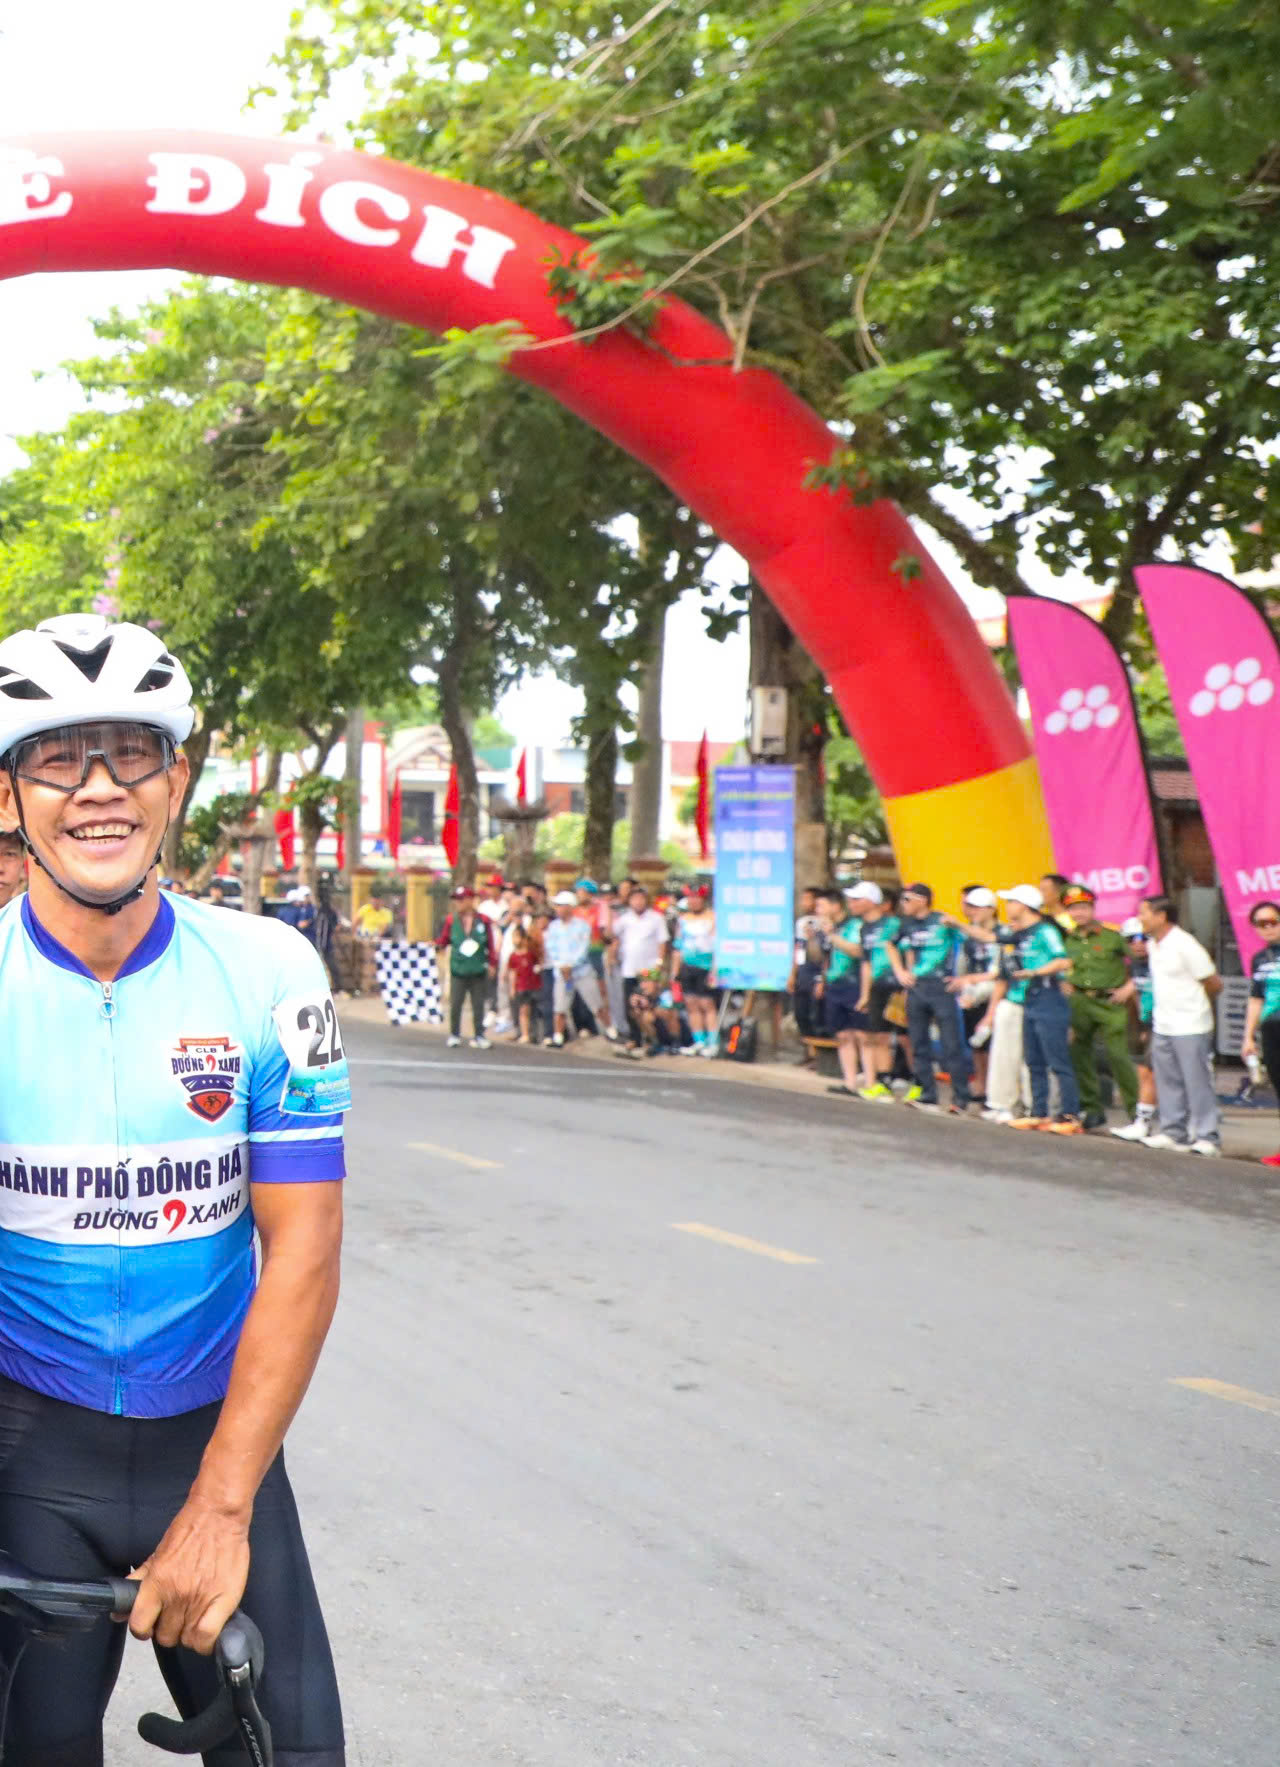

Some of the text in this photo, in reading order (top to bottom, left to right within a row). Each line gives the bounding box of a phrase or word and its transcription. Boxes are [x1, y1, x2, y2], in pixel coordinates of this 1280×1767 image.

[146, 151, 516, 289] ĐÍCH
[218, 1056, 241, 1074] XANH
[76, 1154, 132, 1201] PHỐ
[136, 1156, 212, 1198] ĐÔNG
[218, 1143, 242, 1182] HÀ
[73, 1190, 242, 1231] ĐƯỜNG XANH
